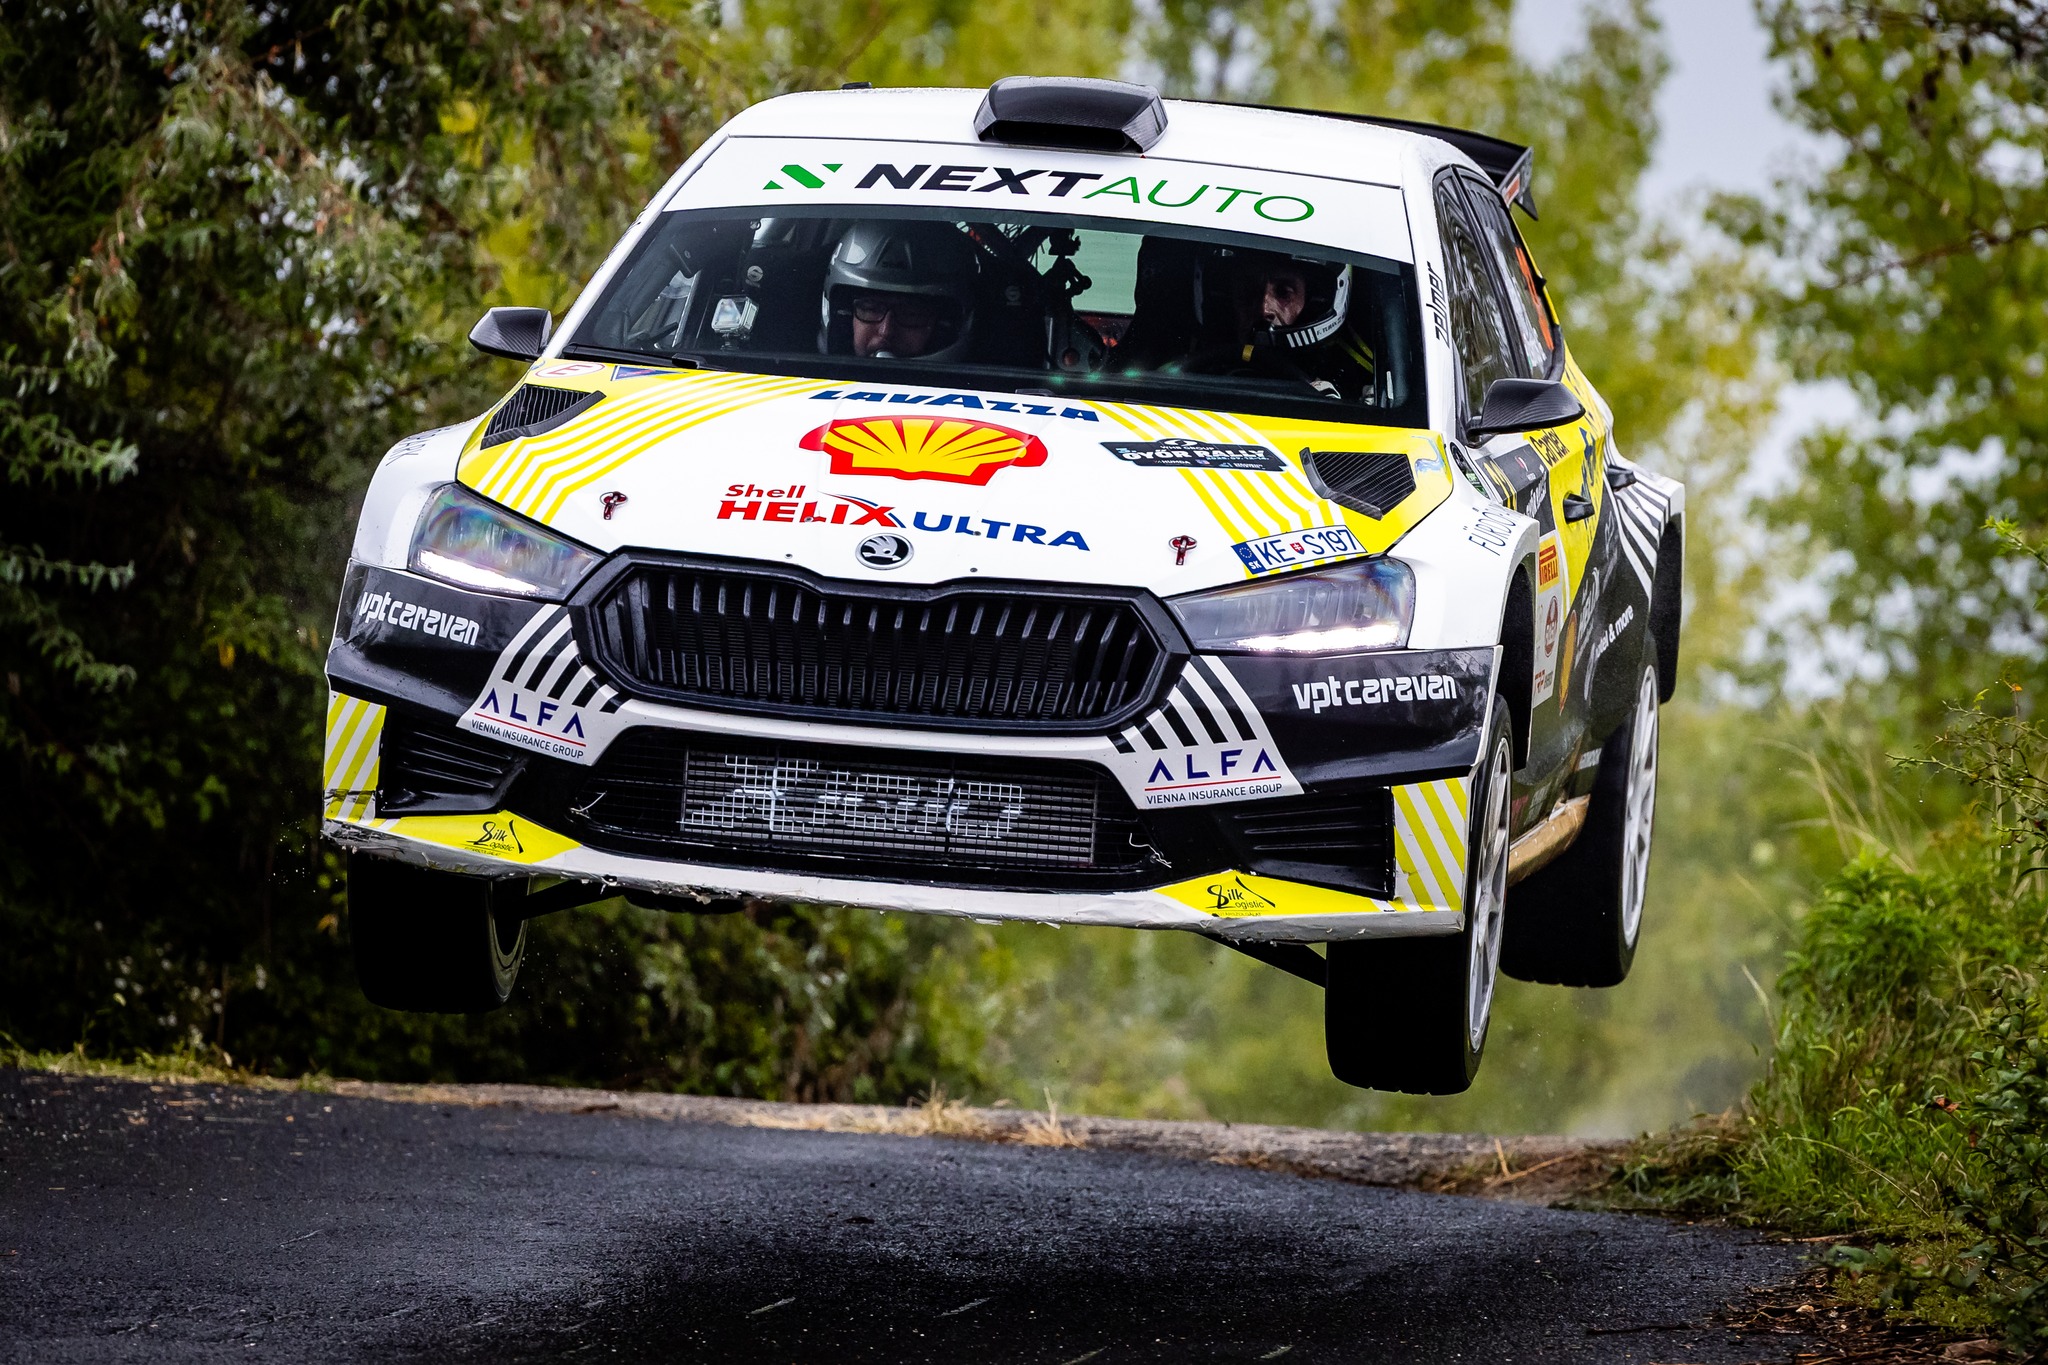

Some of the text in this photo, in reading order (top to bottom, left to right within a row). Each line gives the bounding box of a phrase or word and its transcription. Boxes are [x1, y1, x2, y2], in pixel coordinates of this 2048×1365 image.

[809, 390, 1100, 422] LAVAZZA
[1193, 450, 1265, 459] RALLY
[725, 484, 807, 499] Shell
[717, 499, 1091, 552] HELIX ULTRA
[1254, 529, 1357, 565] KE S197
[1248, 560, 1262, 570] SK
[1539, 545, 1559, 586] PIRELLI
[1608, 623, 1616, 643] &
[1615, 605, 1633, 636] more
[480, 687, 585, 738] ALFA
[471, 719, 584, 759] VIENNA INSURANCE GROUP
[1148, 748, 1277, 783] ALFA
[1146, 783, 1282, 804] VIENNA INSURANCE GROUP
